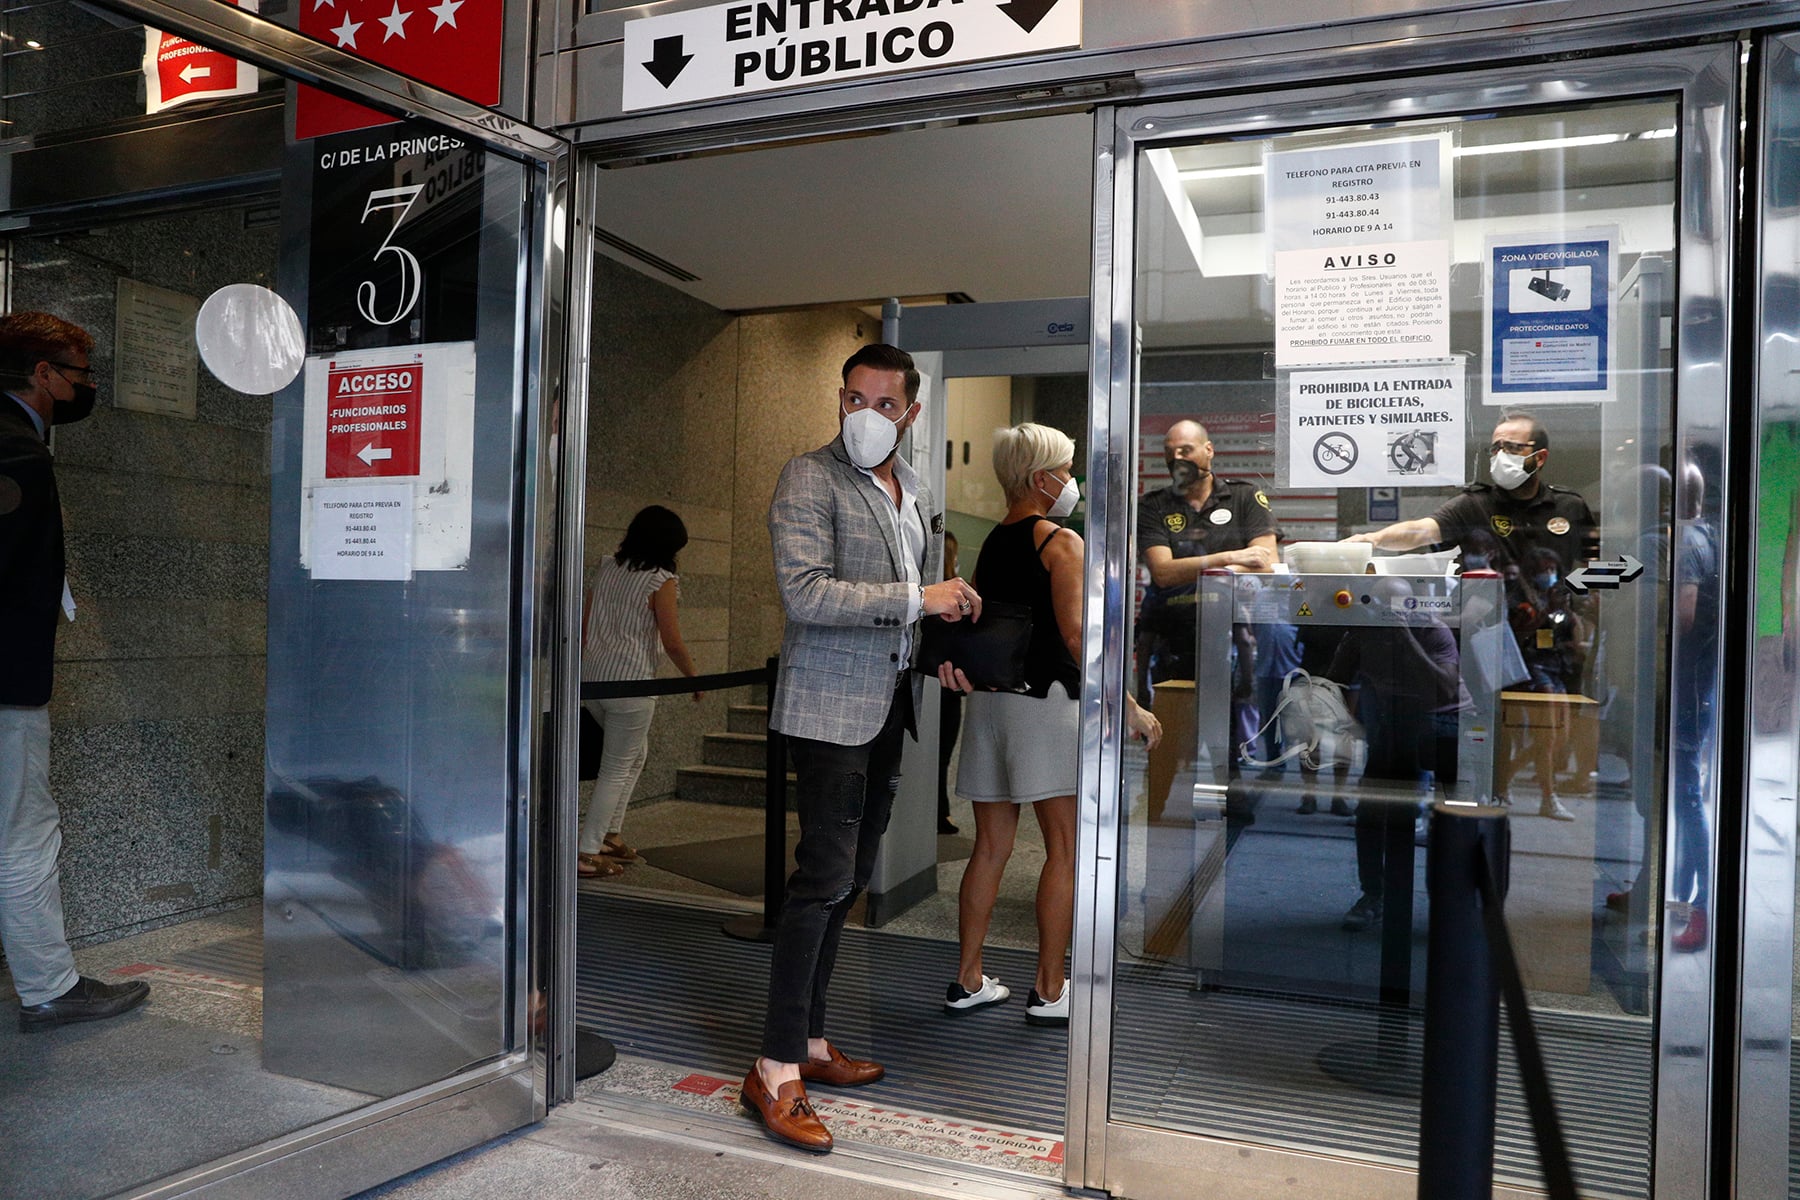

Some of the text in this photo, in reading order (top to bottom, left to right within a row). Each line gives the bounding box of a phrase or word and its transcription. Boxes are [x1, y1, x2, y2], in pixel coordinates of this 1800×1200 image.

[726, 0, 964, 42] ENTRAD
[734, 21, 955, 87] PÚBLICO
[320, 135, 465, 169] C/ DE LA PRINCES
[1286, 160, 1421, 179] TELEFONO PARA CITA PREVIA EN
[1332, 178, 1373, 188] REGISTRO
[1325, 193, 1380, 204] 91-443.80.43
[1325, 208, 1380, 220] 91-443.80.44
[1312, 222, 1393, 236] HORARIO DE 9 A 14
[357, 183, 426, 325] 3
[1501, 250, 1600, 263] ZONA VIDEOVIGILADA
[338, 371, 413, 393] ACCESO
[1299, 378, 1453, 394] PROHIBIDA LA ENTRADA
[1325, 396, 1424, 410] DE BICICLETAS,
[1298, 411, 1453, 426] PATINETES Y SIMILARES.
[722, 1087, 741, 1095] PO
[860, 1113, 876, 1121] LA
[879, 1117, 946, 1134] DISTANCIA
[948, 1130, 965, 1138] DE
[969, 1133, 1048, 1153] SEGURIDAD
